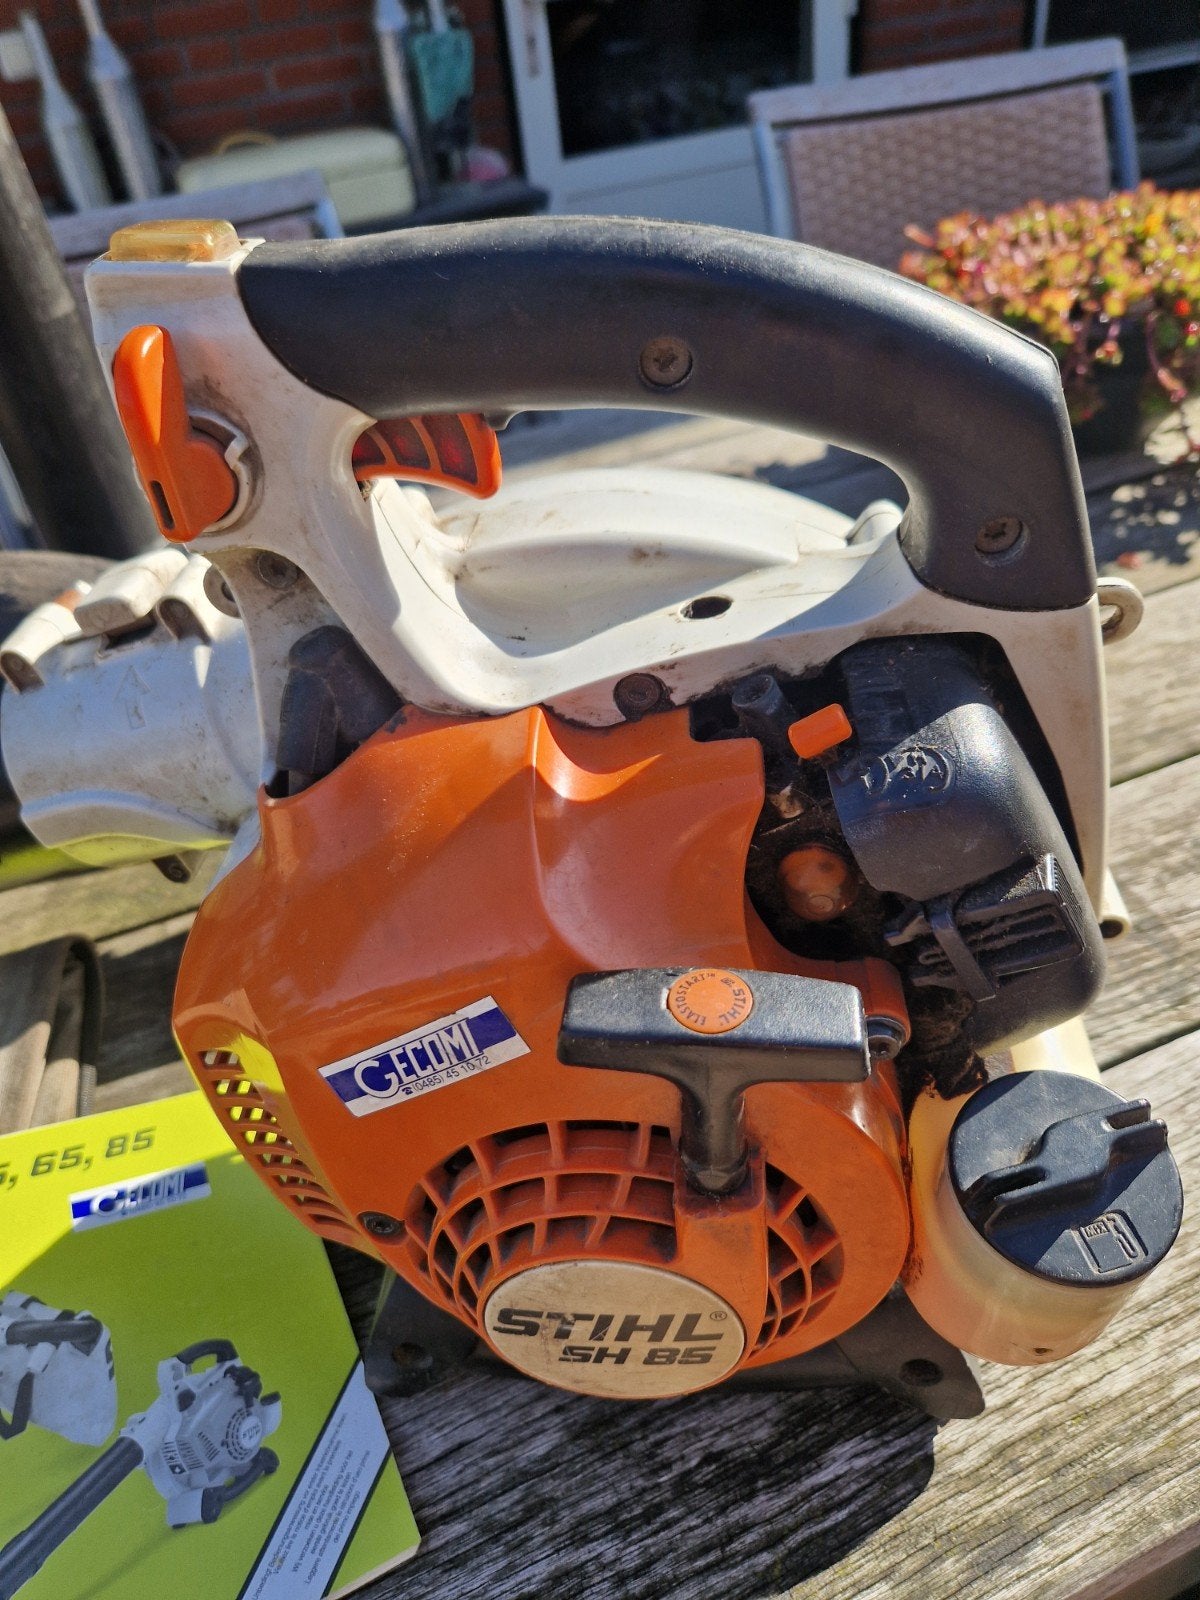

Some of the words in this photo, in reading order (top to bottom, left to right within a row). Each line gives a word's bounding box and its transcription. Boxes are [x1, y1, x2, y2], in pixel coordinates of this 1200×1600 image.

[719, 988, 746, 1027] STIHL
[353, 1019, 480, 1098] GECOMI
[412, 1074, 445, 1093] (0485)
[446, 1068, 460, 1079] 45
[477, 1055, 491, 1067] 72
[30, 1143, 93, 1177] 65,
[105, 1126, 157, 1158] 85
[493, 1307, 724, 1343] STIHL
[558, 1345, 632, 1365] SH
[642, 1346, 717, 1366] 85
